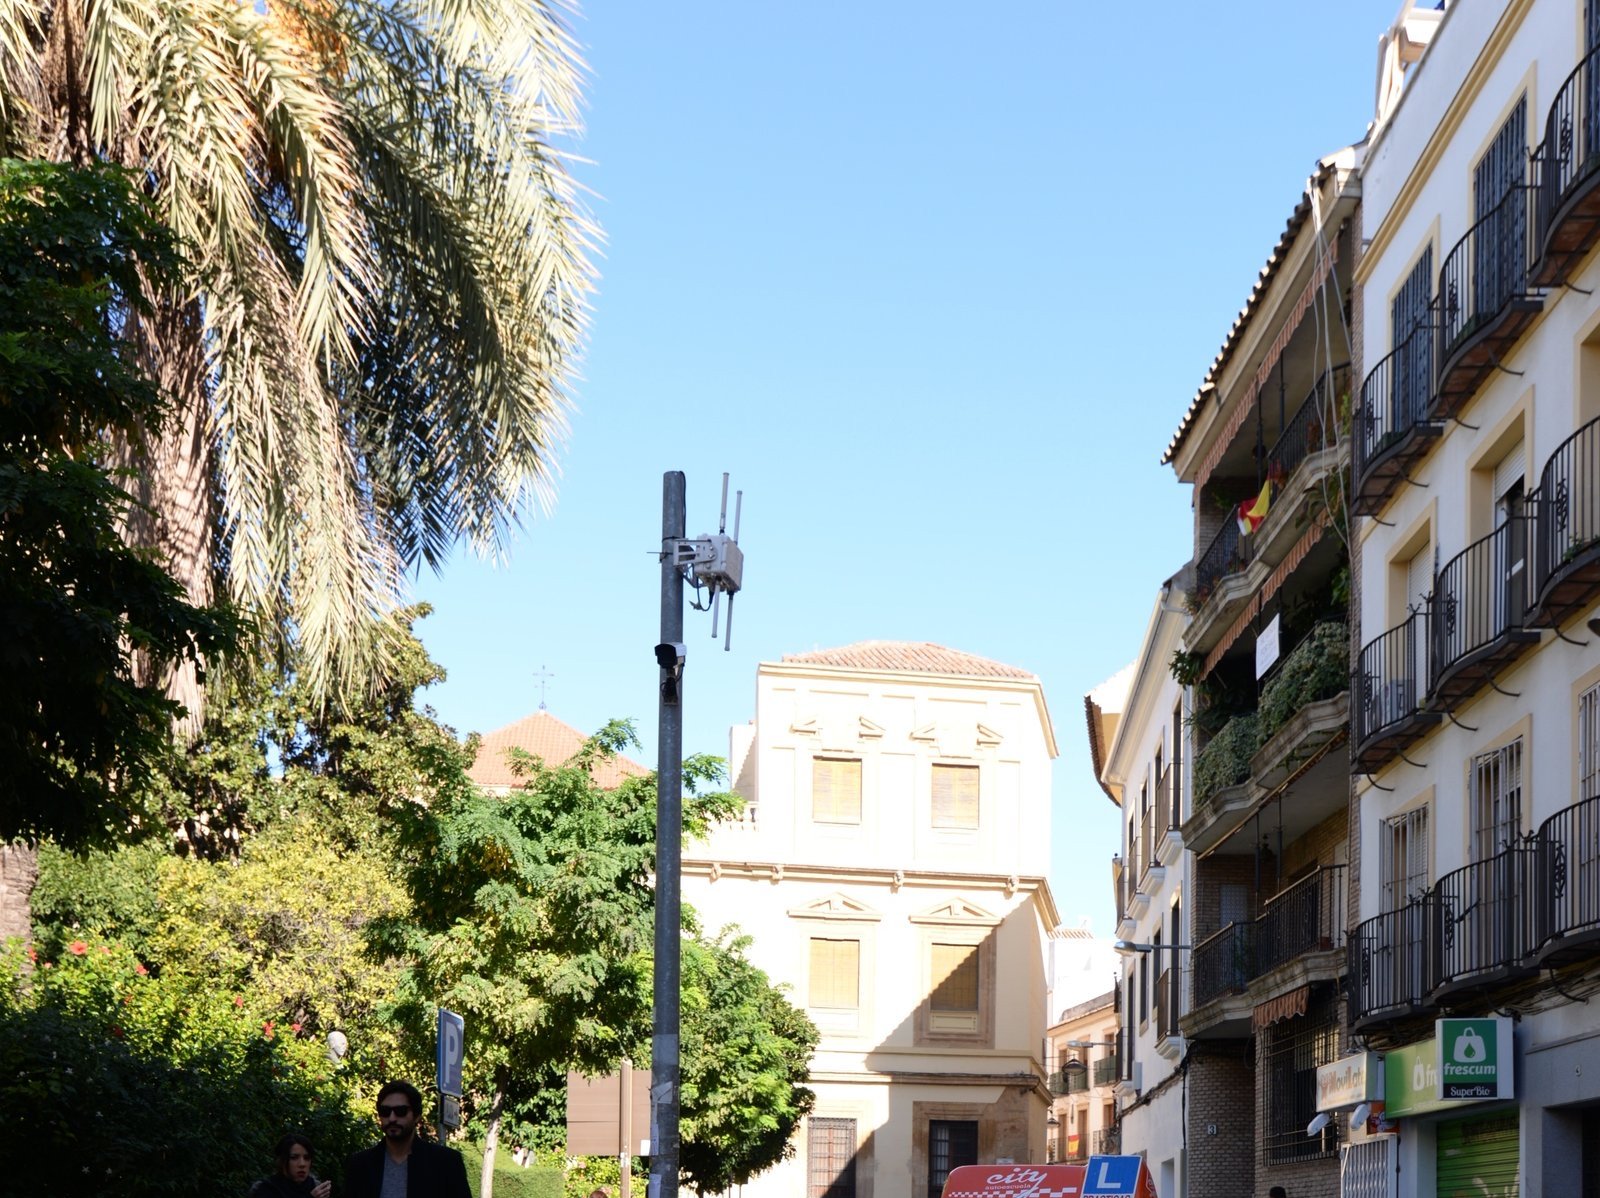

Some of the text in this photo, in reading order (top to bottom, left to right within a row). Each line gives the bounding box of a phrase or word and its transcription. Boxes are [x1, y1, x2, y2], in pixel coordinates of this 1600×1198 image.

[445, 1022, 459, 1083] P
[1443, 1062, 1496, 1075] frescum
[1209, 1125, 1215, 1135] 3
[1096, 1162, 1121, 1189] L
